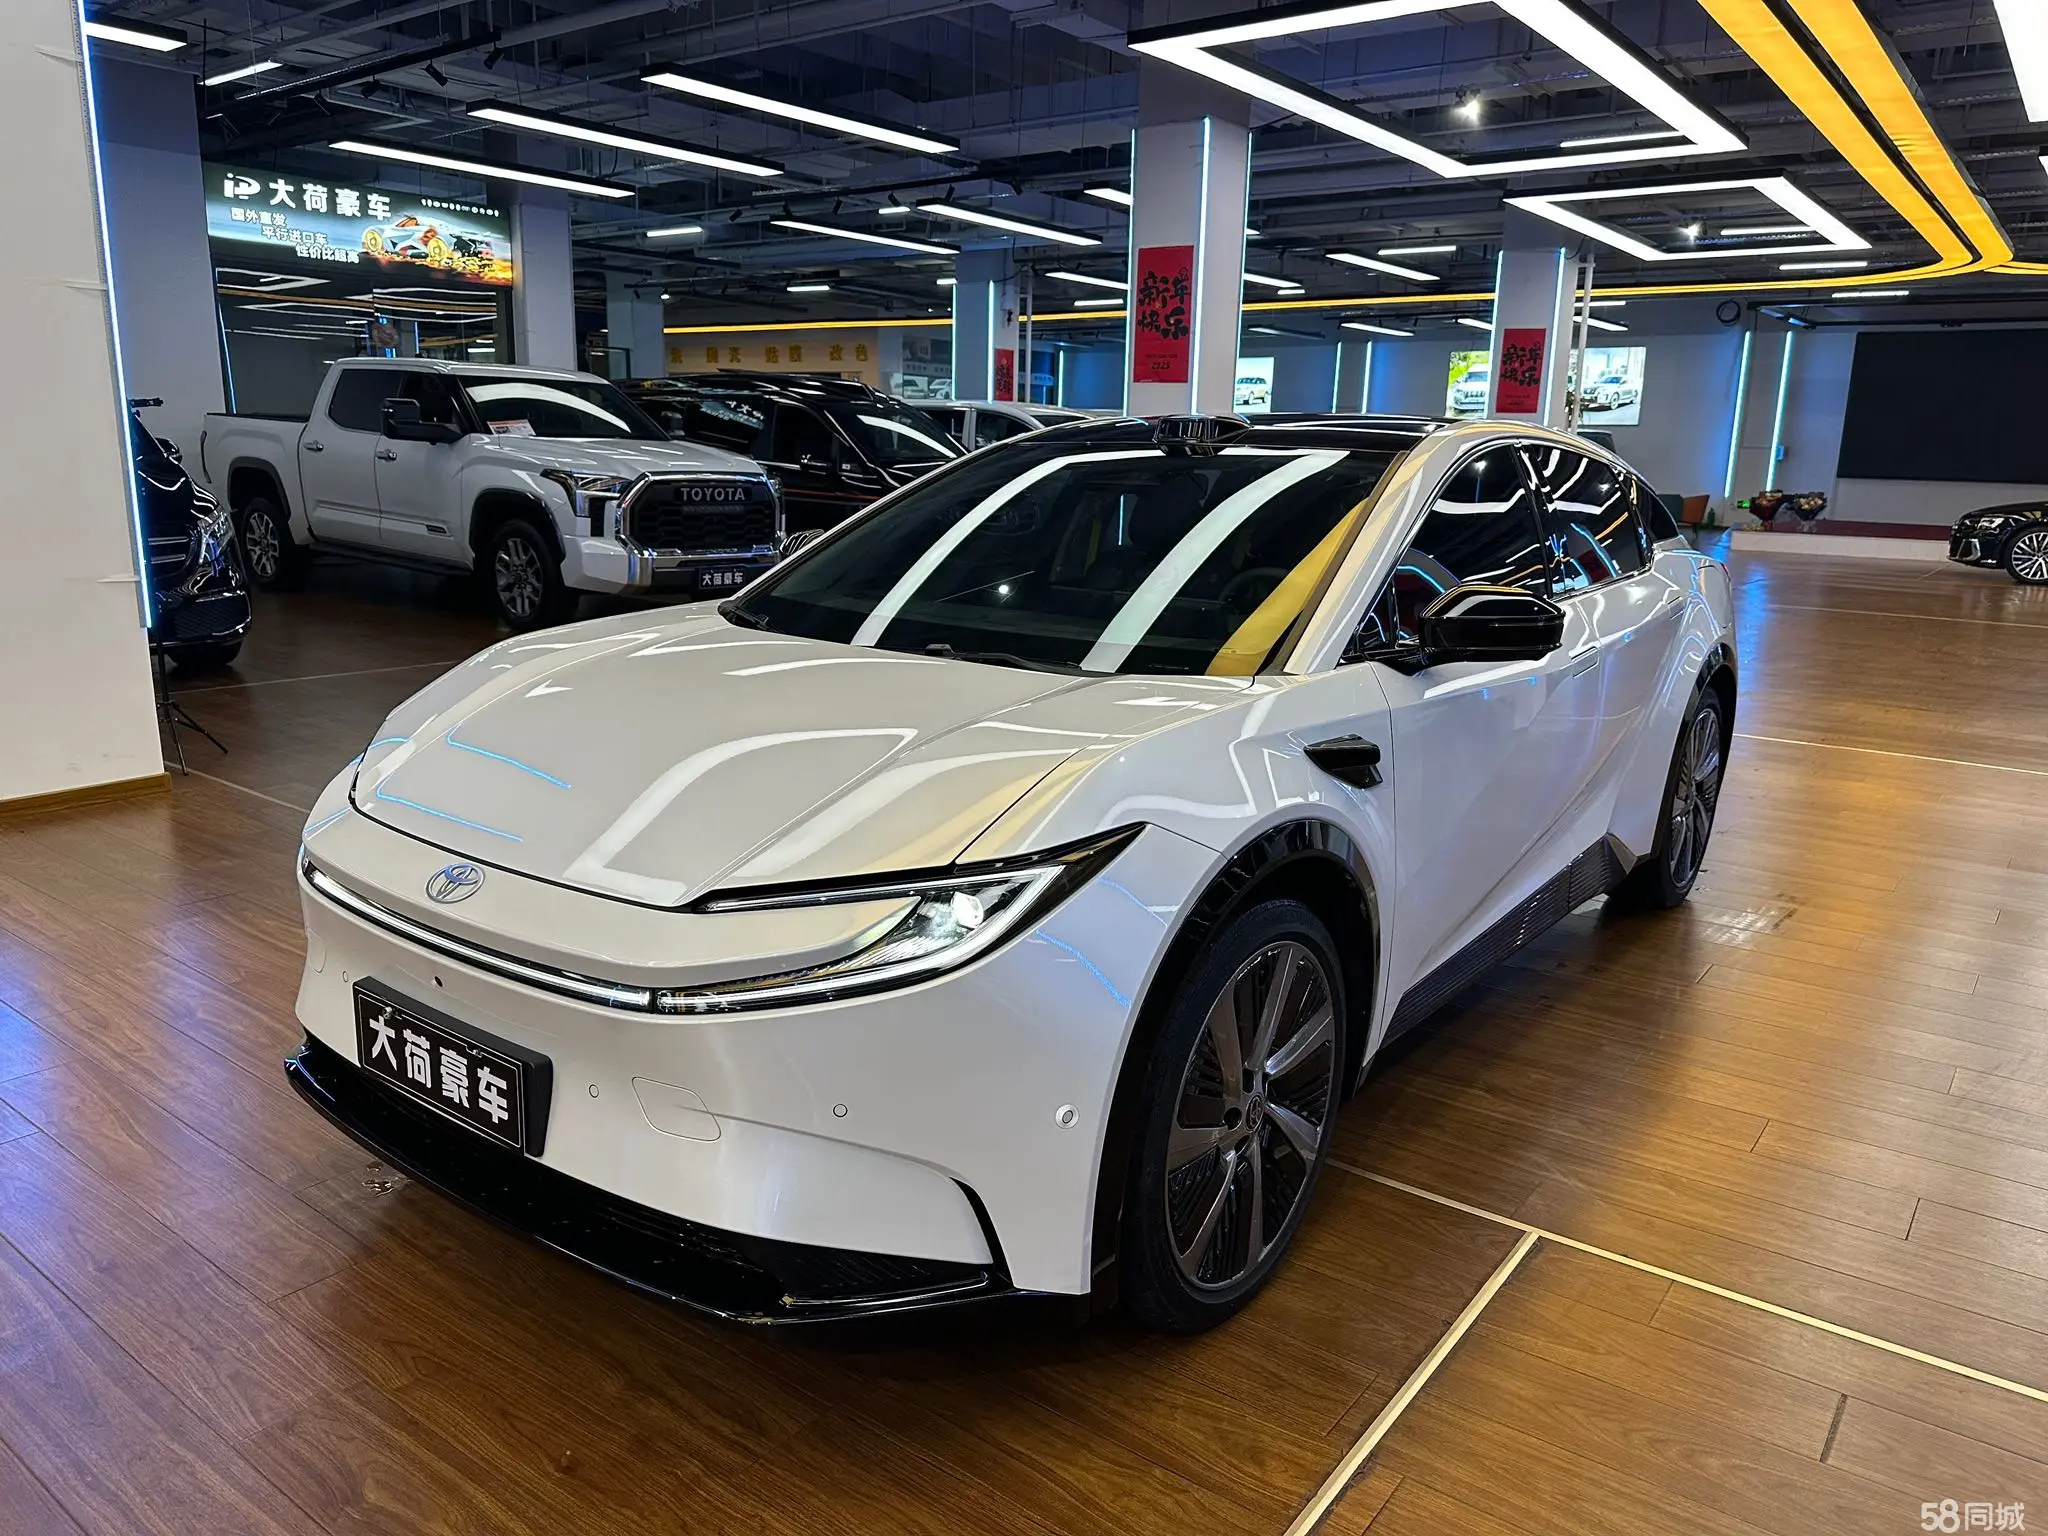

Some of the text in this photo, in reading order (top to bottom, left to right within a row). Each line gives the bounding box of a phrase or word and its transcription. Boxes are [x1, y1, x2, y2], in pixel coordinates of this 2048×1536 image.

[269, 178, 392, 221] 大荷豪车
[230, 207, 288, 227] 国外直发
[261, 225, 328, 246] 平行进口车
[295, 243, 360, 264] 性价比超高
[680, 487, 746, 502] TOYOTA
[702, 571, 744, 587] 大荷豪车
[369, 1015, 509, 1124] 大荷豪车
